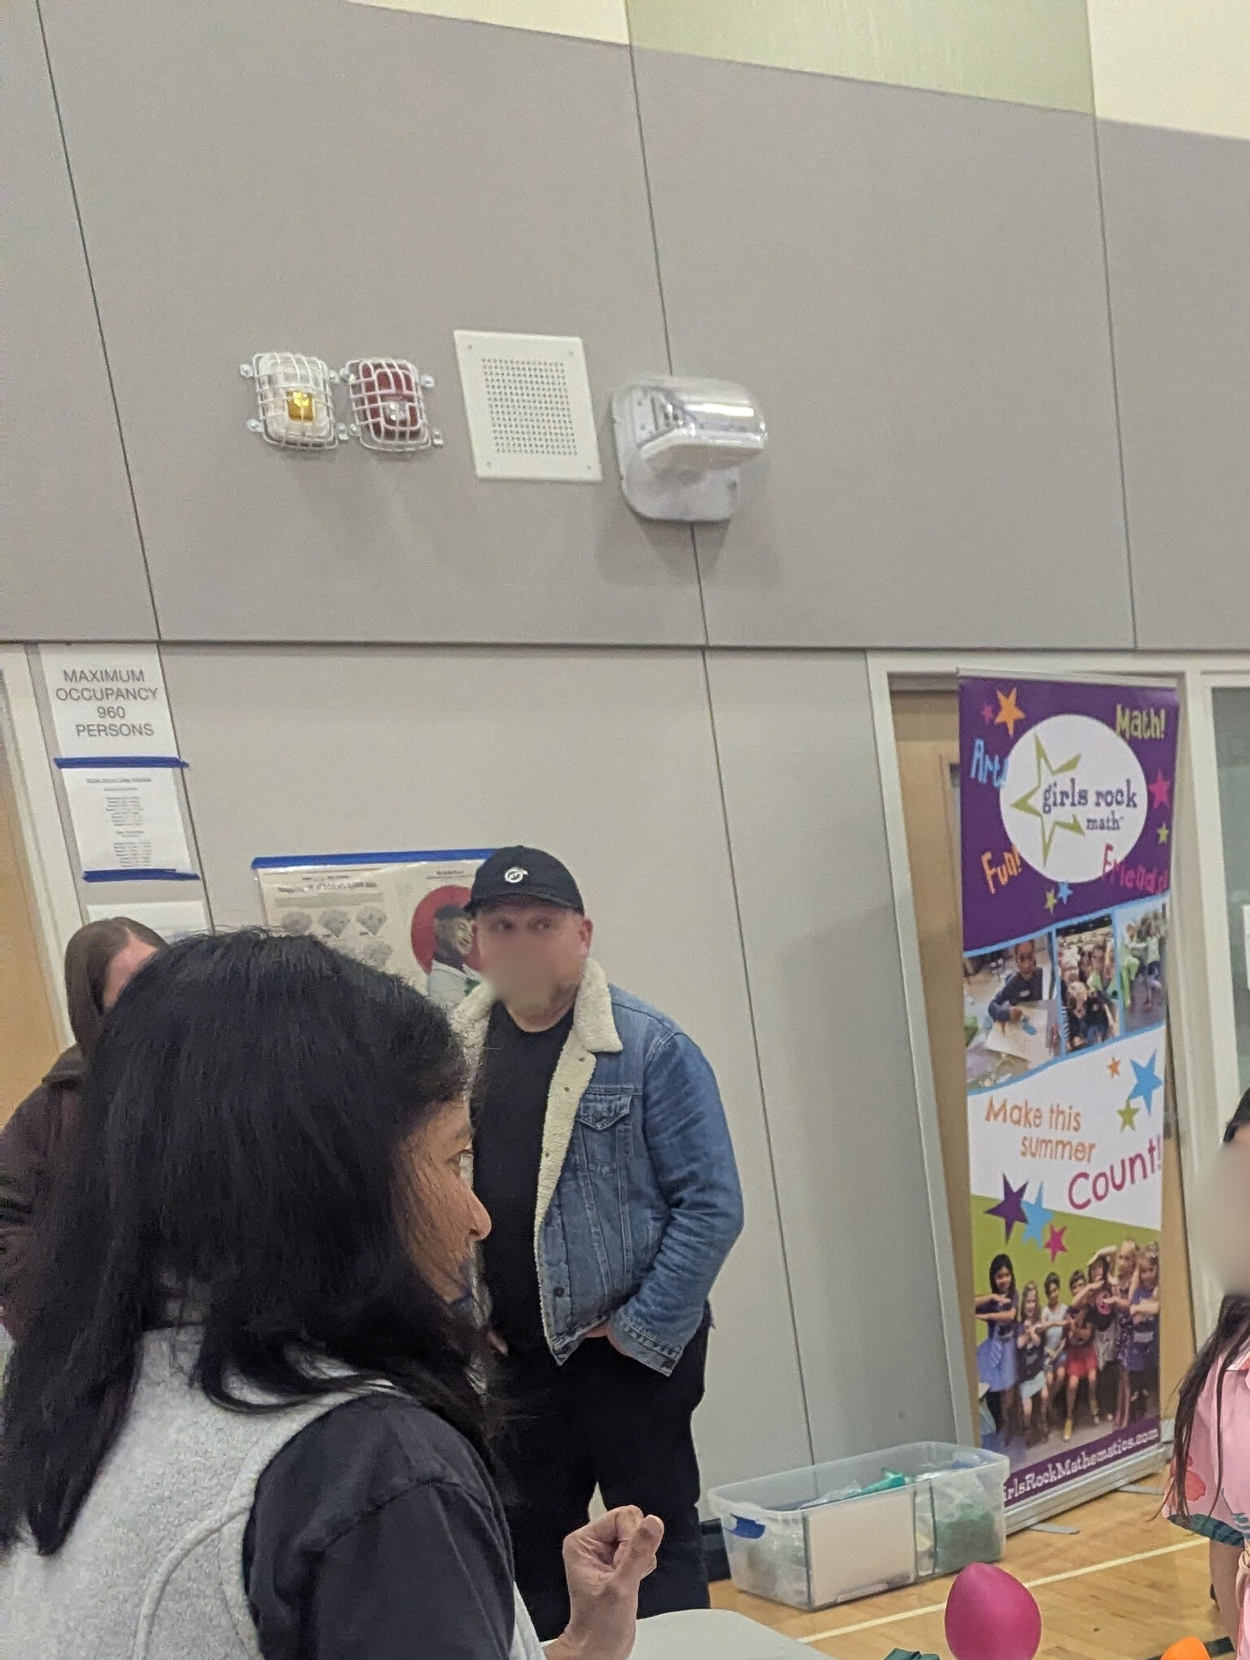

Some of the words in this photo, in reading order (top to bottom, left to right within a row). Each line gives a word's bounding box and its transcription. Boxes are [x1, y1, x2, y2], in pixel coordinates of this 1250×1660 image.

[63, 669, 145, 683] MAXIMUM
[55, 687, 158, 701] OCCUPANCY
[97, 706, 126, 719] 960
[1115, 703, 1165, 740] Math!
[76, 723, 155, 737] PERSONS
[1042, 777, 1089, 814] girls
[1094, 778, 1138, 808] rock
[1085, 810, 1121, 831] math
[980, 844, 1023, 895] Fun!
[984, 1096, 1043, 1128] Make
[1048, 1102, 1082, 1132] this
[1020, 1136, 1096, 1164] summer
[1067, 1134, 1162, 1210] Count!
[1003, 1428, 1159, 1500] irlsRockMathematics.com
